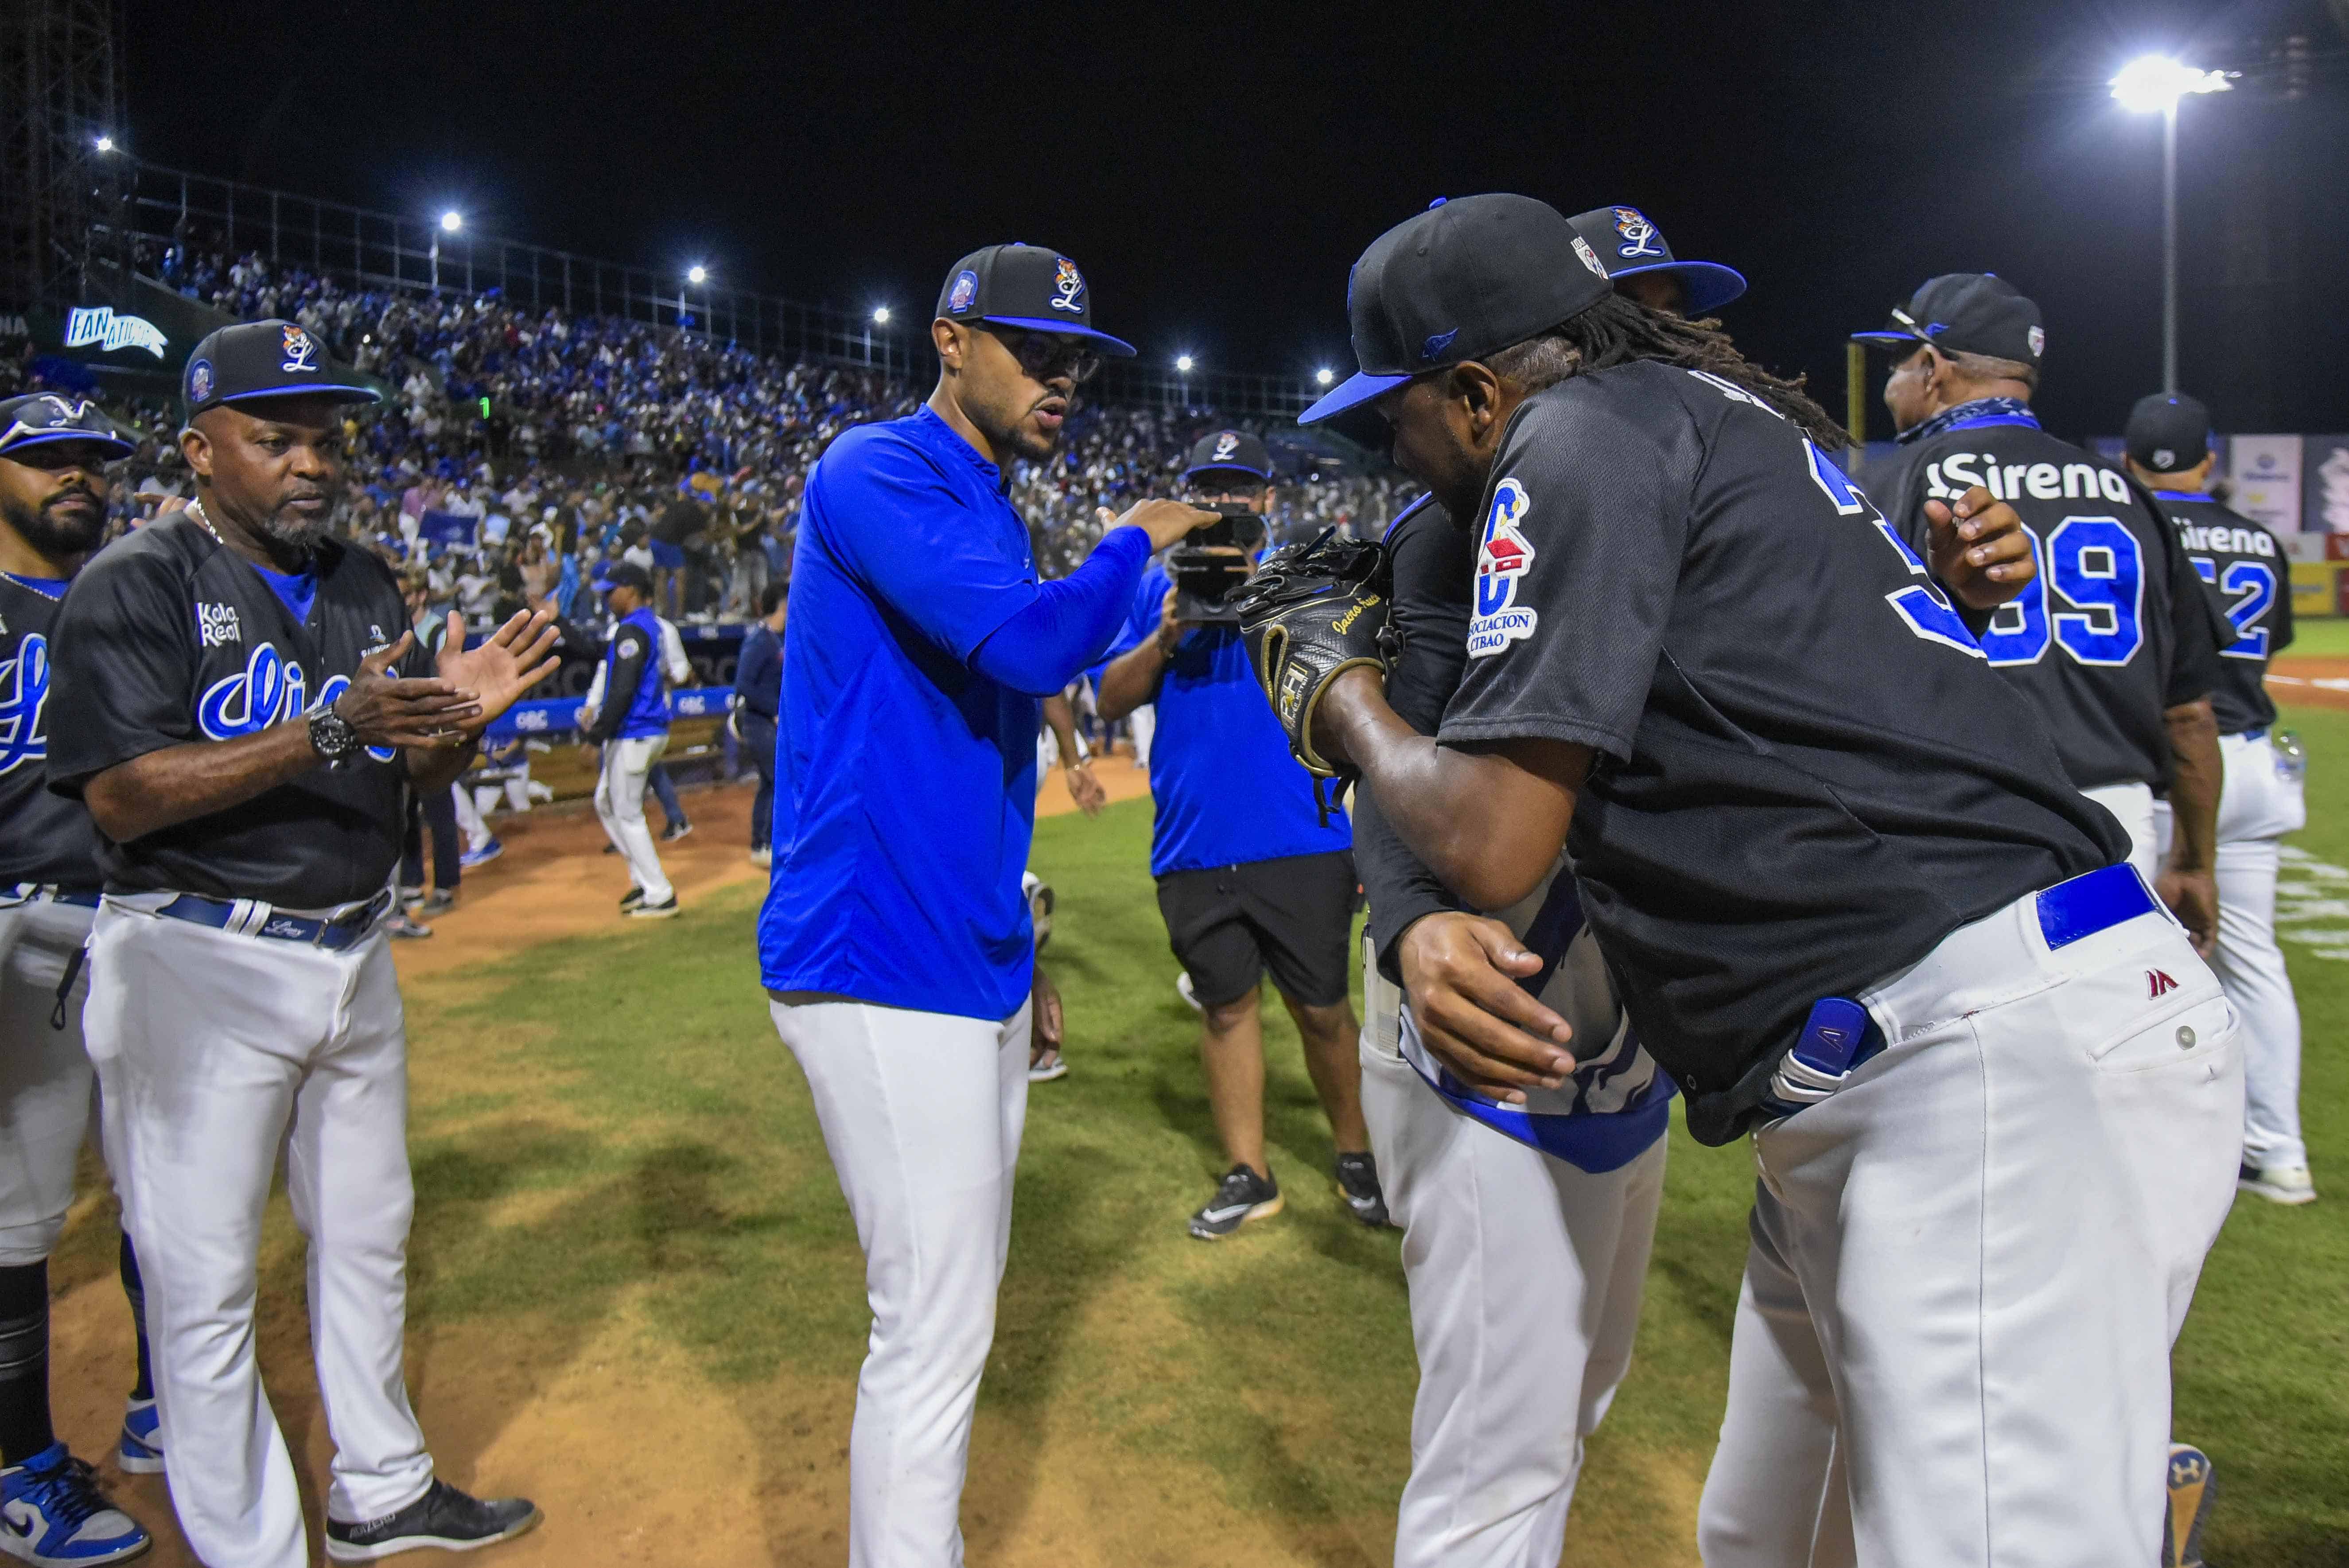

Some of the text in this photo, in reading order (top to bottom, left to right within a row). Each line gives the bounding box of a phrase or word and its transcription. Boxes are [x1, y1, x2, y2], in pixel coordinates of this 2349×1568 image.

[195, 602, 239, 627] Kola
[2189, 557, 2277, 661] 2
[200, 621, 241, 647] Real
[1470, 633, 1504, 652] CIBAO
